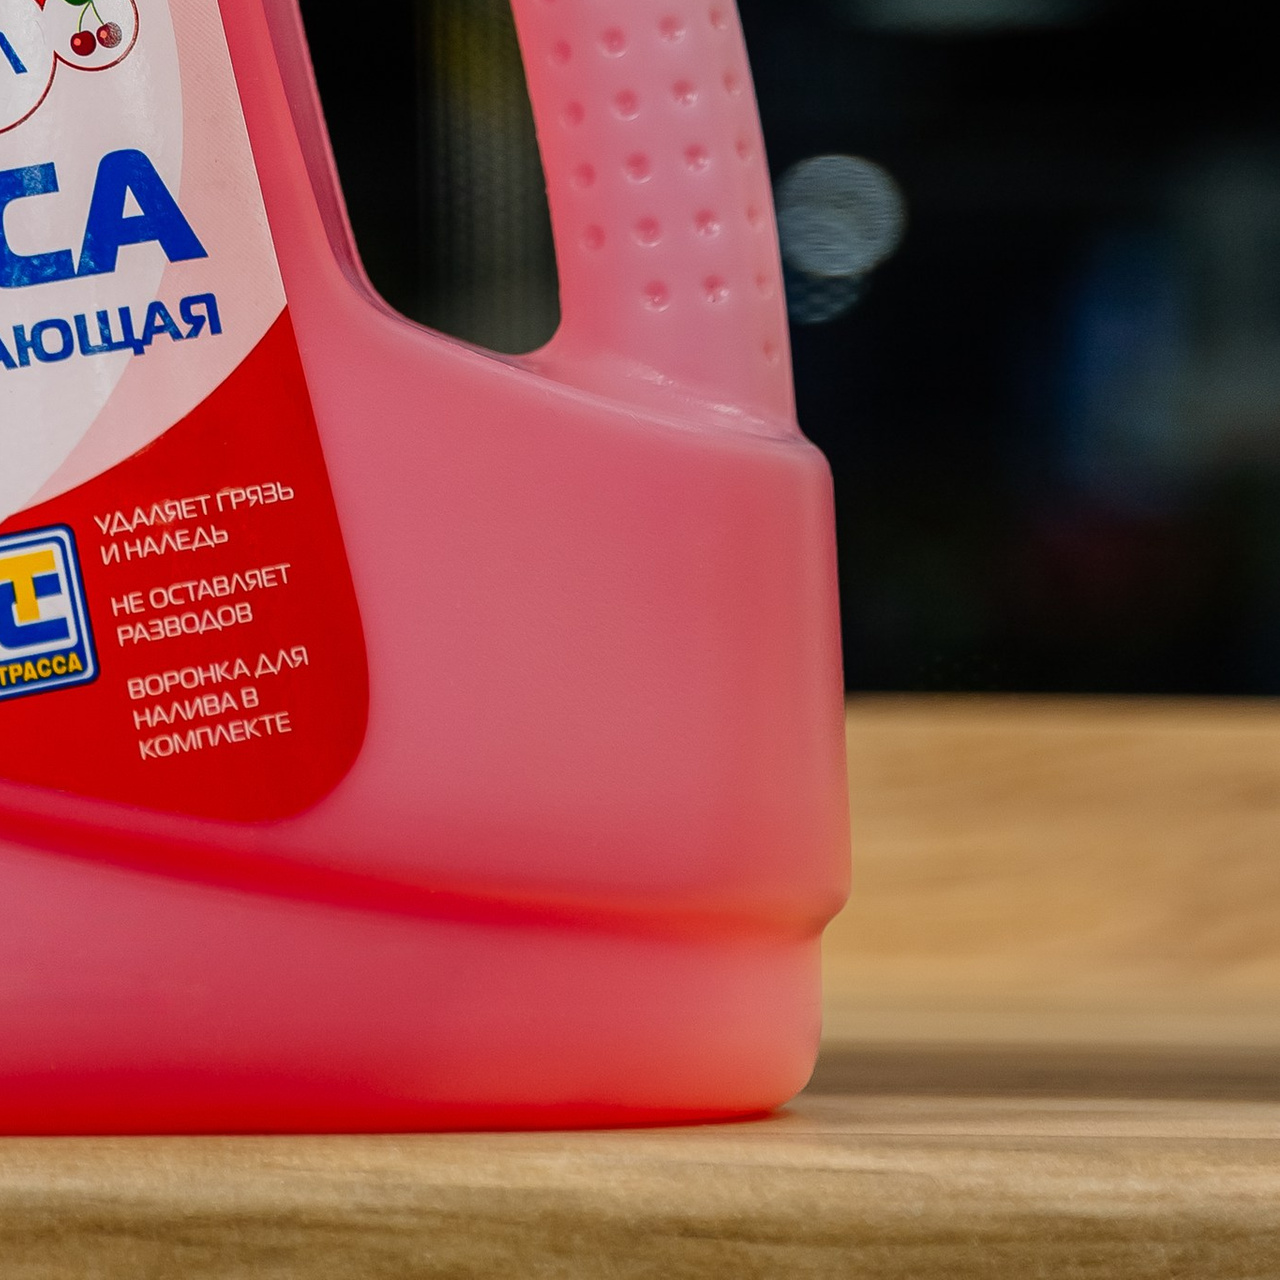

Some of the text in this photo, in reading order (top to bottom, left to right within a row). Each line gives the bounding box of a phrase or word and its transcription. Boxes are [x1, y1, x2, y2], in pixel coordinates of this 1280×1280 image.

[93, 481, 294, 537] УДАЛЯЕТ ГРЯЗЬ
[100, 524, 229, 566] И НАЛЕДЬ
[110, 563, 291, 617] НЕ ОСТАВЛЯЕТ
[116, 602, 253, 647] РАЗВОДОВ
[127, 645, 309, 700] ВОРОНКА ДЛЯ
[133, 686, 259, 730] НАЛИВА В
[138, 711, 292, 760] КОМПЛЕКТЕ
